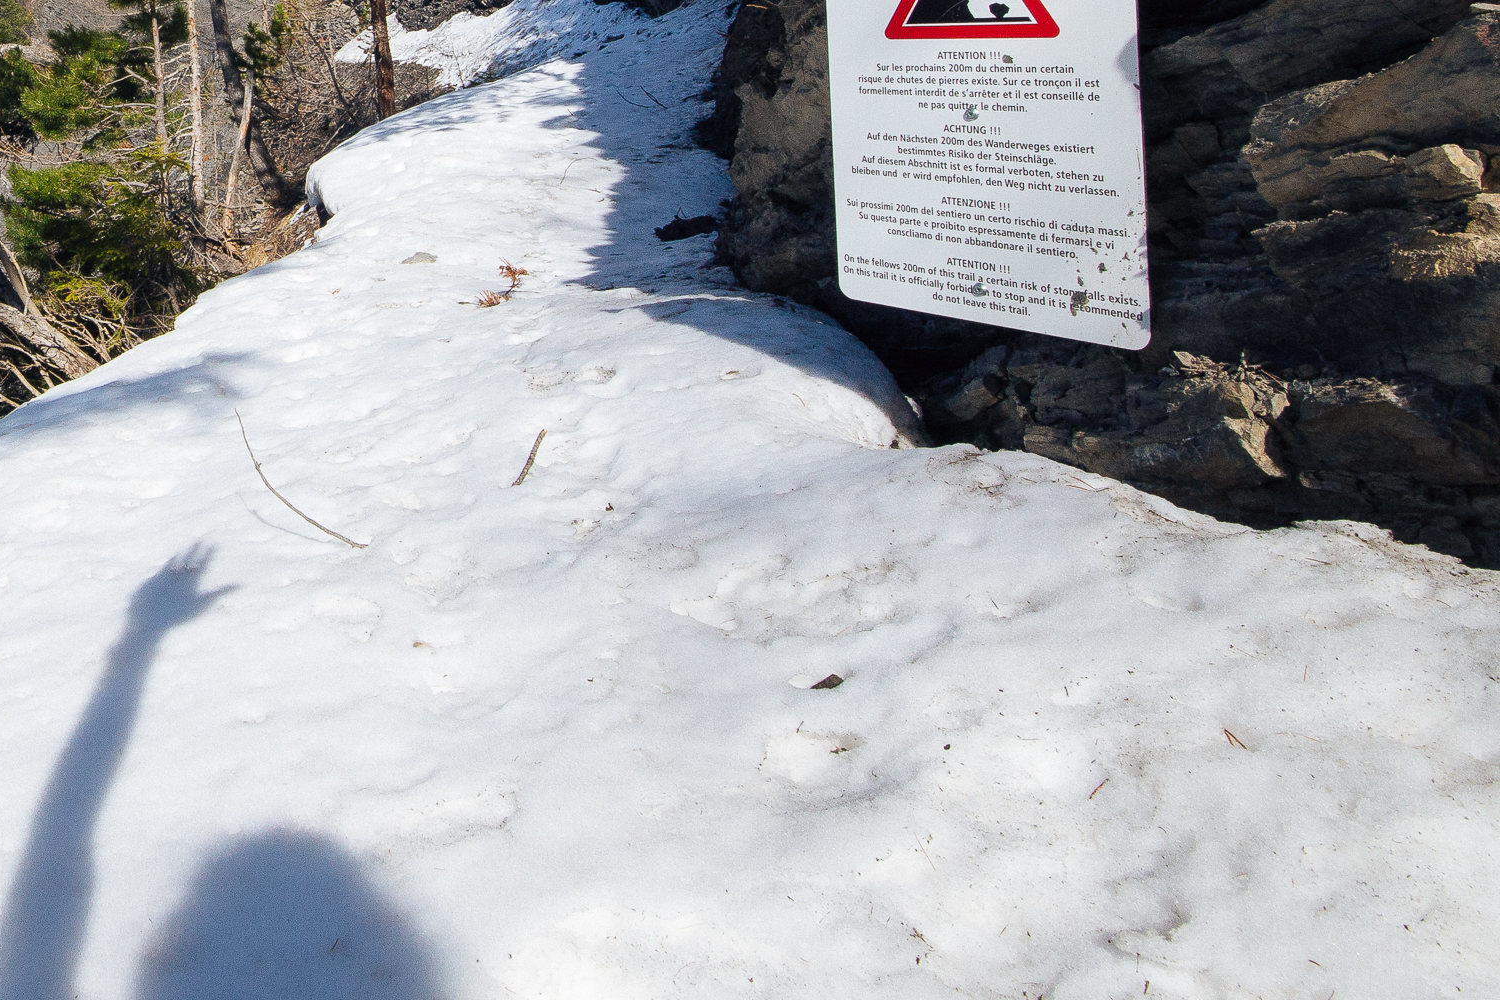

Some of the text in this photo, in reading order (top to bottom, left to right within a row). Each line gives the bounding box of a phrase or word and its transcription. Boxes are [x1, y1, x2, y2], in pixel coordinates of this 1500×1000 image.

[906, 64, 946, 73] prochains
[949, 64, 972, 72] 200m
[976, 64, 986, 72] du
[990, 64, 1022, 72] chemin
[1040, 65, 1074, 73] certain
[858, 75, 882, 84] risque
[897, 75, 923, 84] chutes
[939, 76, 968, 86] pierres
[972, 77, 1000, 85] existe.
[1003, 77, 1017, 85] Sur
[1035, 79, 1071, 89] tronçon
[1075, 78, 1081, 87] il
[1085, 79, 1100, 87] est
[859, 86, 912, 95] formellement
[915, 88, 946, 96] interdit
[1016, 90, 1020, 98] il
[1042, 92, 1084, 100] conseillé
[1088, 92, 1100, 101] de
[948, 102, 977, 111] quitter
[981, 102, 988, 110] le
[992, 103, 1027, 112] chemin.
[944, 125, 1001, 135] ACHTUNG !!!
[883, 133, 897, 141] den
[900, 134, 938, 143] Nächsten
[941, 137, 964, 145] 200m
[968, 138, 982, 146] des
[985, 139, 1050, 152] Wanderweges
[1054, 144, 1094, 153] existiert
[898, 146, 1056, 166] bestimmtes Risiko der Steinschläge.
[878, 156, 905, 166] diesem
[908, 159, 947, 169] Abschnitt
[950, 162, 960, 170] ist
[975, 164, 1005, 174] formal
[1008, 167, 1053, 179] verboten,
[1056, 170, 1089, 181] stehen
[852, 166, 880, 175] bleiben
[935, 174, 983, 186] empfohlen,
[986, 178, 1002, 186] den
[1005, 179, 1025, 190] Weg
[1028, 181, 1052, 191] nicht
[1069, 185, 1120, 197] verlassen.
[941, 197, 1010, 211] ATTENZIONE !!!
[847, 199, 1130, 238] Sui prossimi 200m del sentiero un certo rischio di caduta massi.
[871, 213, 897, 223] questa
[900, 217, 921, 226] parte
[932, 220, 965, 231] proibito
[968, 226, 1036, 240] espressamente
[1040, 232, 1048, 241] di
[1052, 233, 1092, 247] fermarsi
[1096, 240, 1101, 248] e
[1105, 240, 1114, 249] vi
[965, 236, 1024, 251] abbandonare
[1027, 244, 1033, 253] il
[1036, 246, 1078, 259] sentiero.
[947, 258, 1010, 274] ATTENTION !!!
[844, 254, 854, 263] On
[857, 256, 869, 265] the
[872, 258, 900, 269] fellows
[903, 263, 926, 273] 200m
[928, 266, 936, 275] of
[940, 268, 955, 278] this
[958, 272, 975, 282] trail
[986, 277, 1017, 288] certain
[1020, 281, 1038, 291] risk
[1041, 284, 1050, 293] of
[1109, 294, 1141, 307] exists.
[844, 265, 854, 274] On
[857, 267, 870, 276] this
[873, 270, 888, 279] trail
[891, 273, 897, 281] it
[900, 274, 905, 282] is
[909, 277, 944, 290] officially
[947, 282, 989, 296] forbidn
[992, 290, 1002, 298] to
[1005, 292, 1025, 302] stop
[1028, 296, 1046, 306] and
[1049, 297, 1055, 307] it
[1059, 299, 1066, 309] is
[932, 292, 1030, 316] do not leave this trail.
